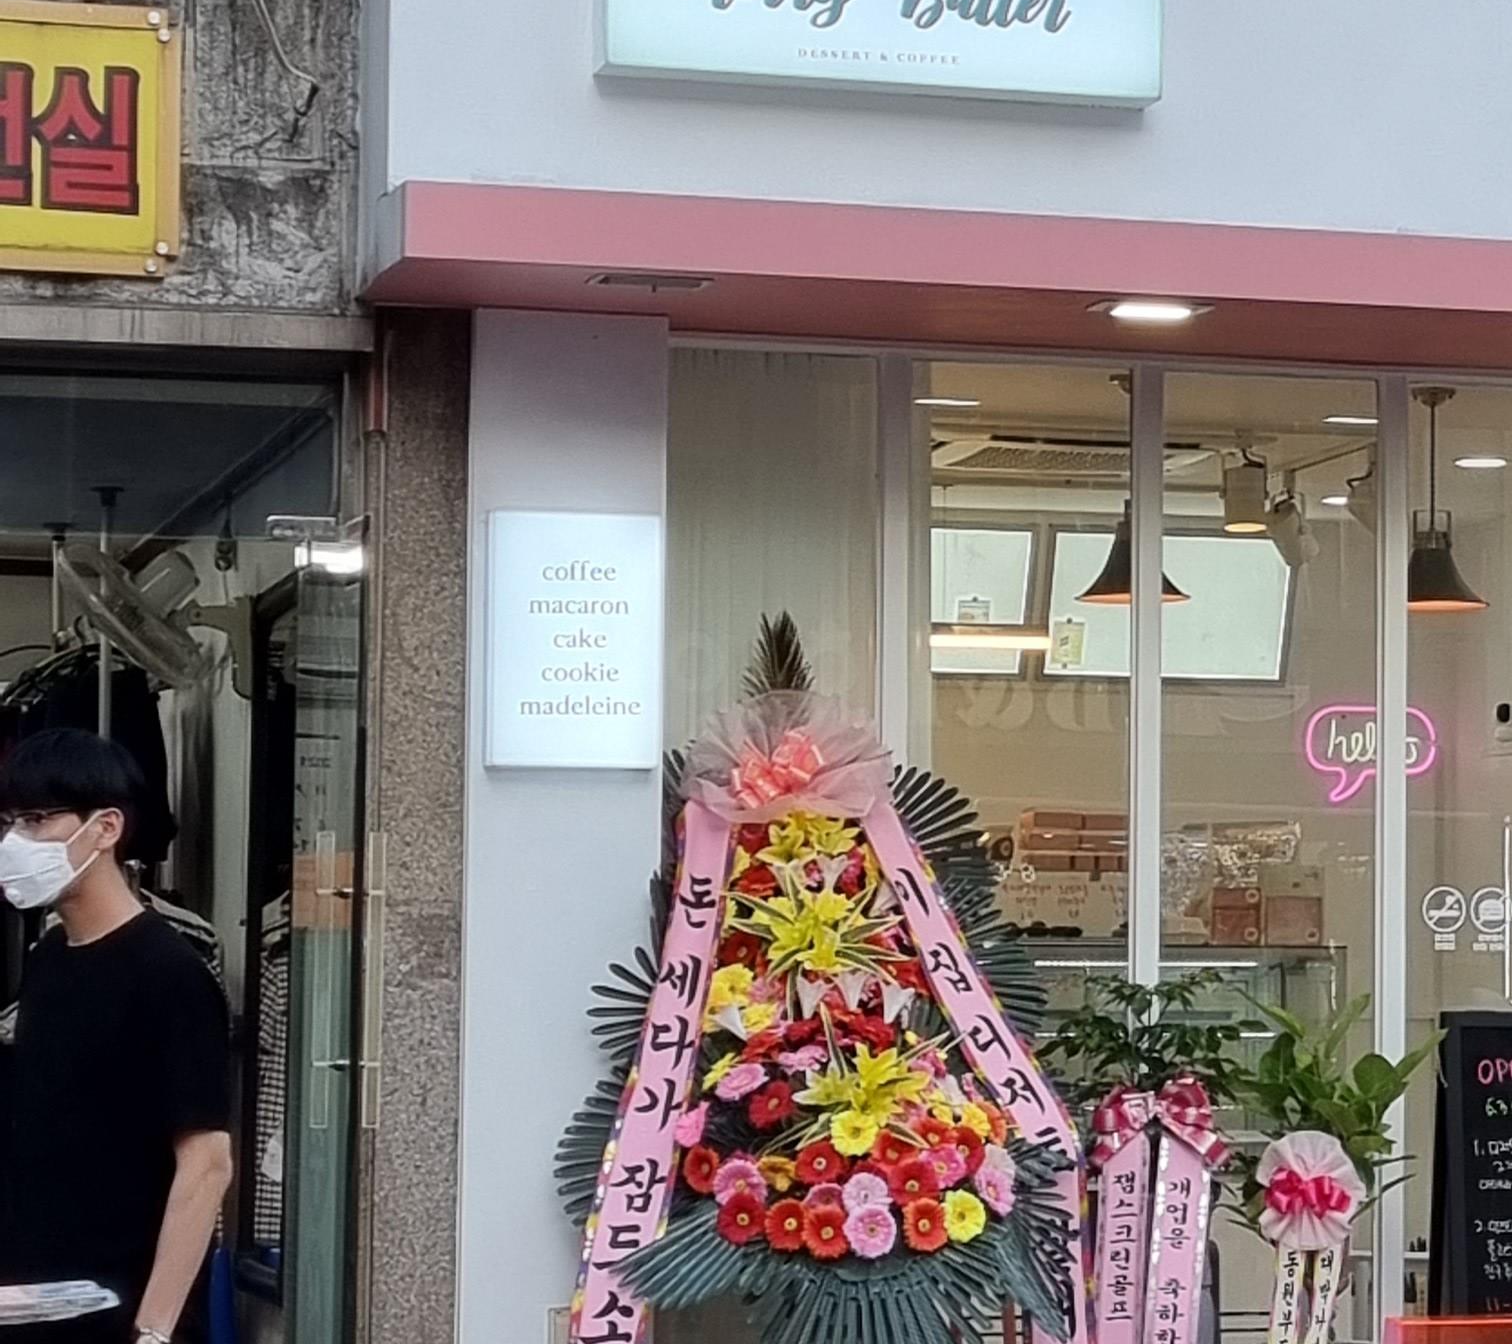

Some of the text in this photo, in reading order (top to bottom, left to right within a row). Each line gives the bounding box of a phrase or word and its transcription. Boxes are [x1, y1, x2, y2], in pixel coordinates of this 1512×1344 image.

[542, 560, 617, 582] coffee
[529, 598, 630, 615] macaron
[553, 627, 608, 649] cake
[541, 661, 620, 682] cookie
[520, 694, 641, 716] madeleine
[1327, 719, 1419, 764] helo
[679, 874, 716, 929] 돈
[894, 868, 930, 916] 이
[634, 954, 702, 1132] 세다가
[1163, 1177, 1191, 1250] 개업을
